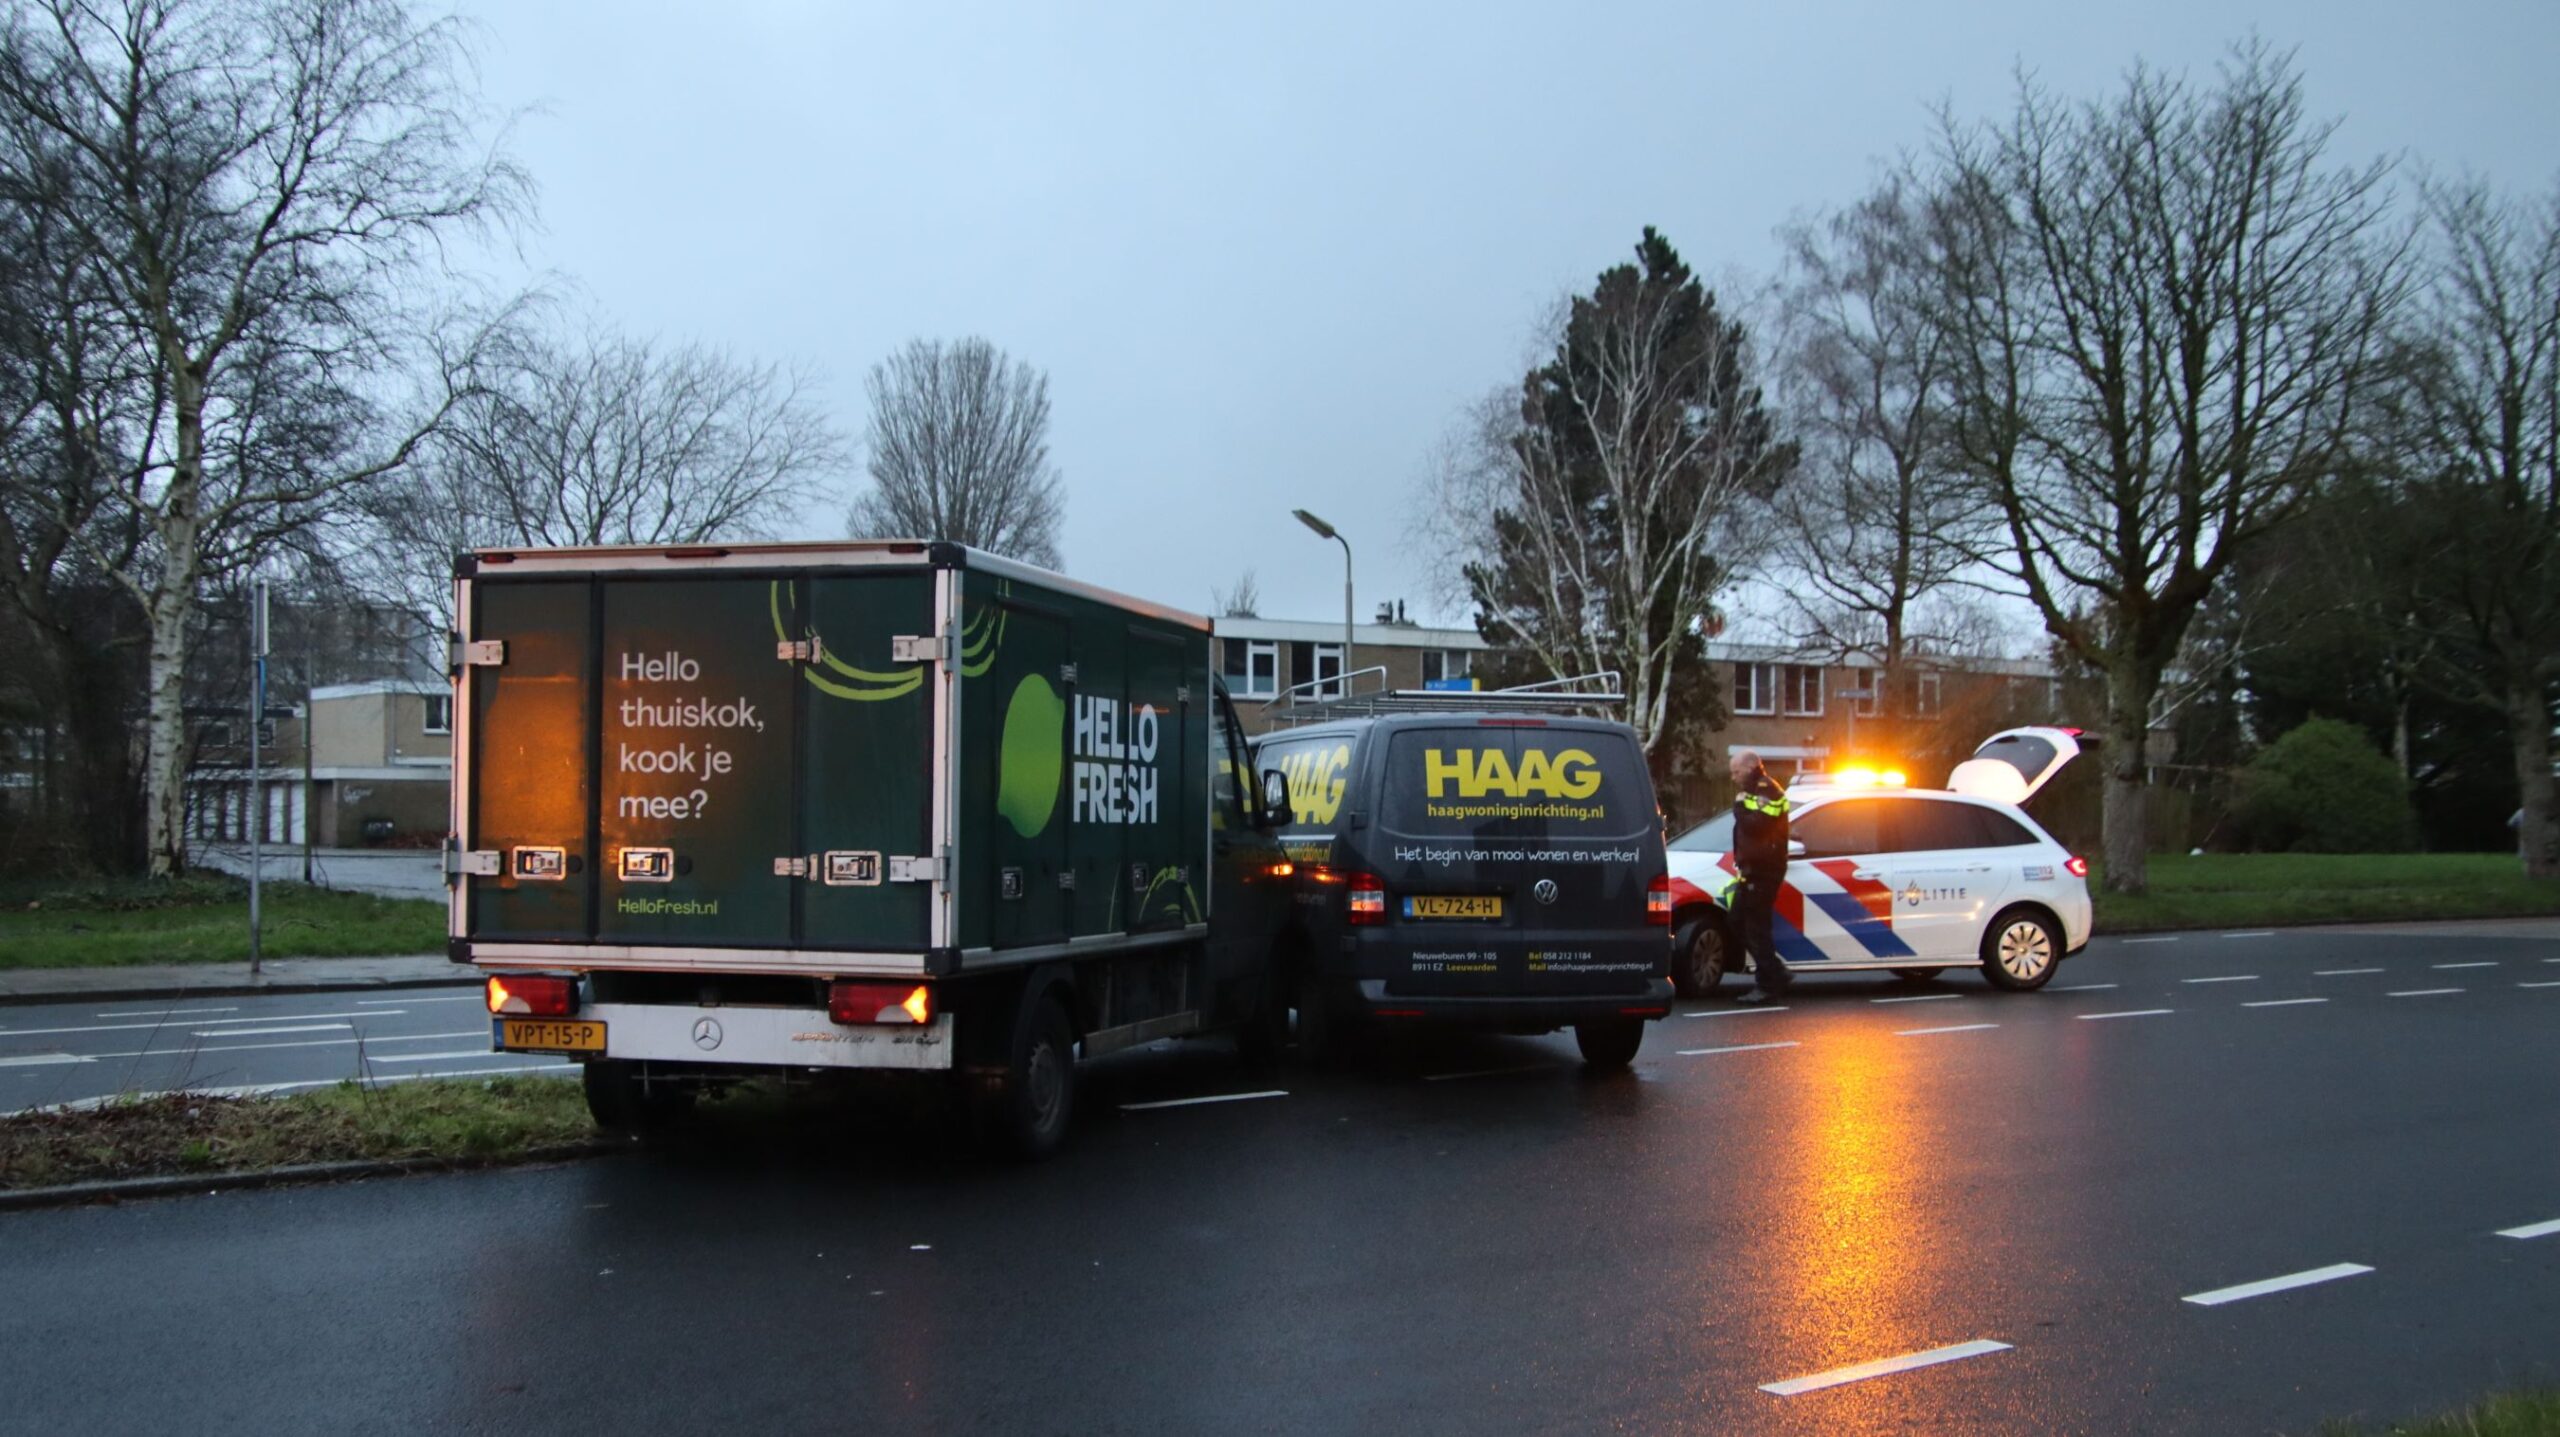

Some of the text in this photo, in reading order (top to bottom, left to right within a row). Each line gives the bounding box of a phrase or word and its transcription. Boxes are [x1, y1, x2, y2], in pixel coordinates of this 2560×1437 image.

[621, 651, 699, 682] Hello
[620, 697, 764, 733] thuiskok,
[1074, 693, 1159, 763] HELLO
[620, 743, 732, 782] kook je
[1425, 748, 1601, 799] HAAG
[619, 789, 708, 819] mee?
[1073, 761, 1158, 825] FRESH
[1427, 803, 1604, 821] haagwoninginrichting.nl
[1394, 846, 1422, 861] Het
[1426, 846, 1461, 867] begin
[1464, 849, 1489, 861] van
[1493, 848, 1525, 861] mooi
[1527, 850, 1570, 861] wonen
[1572, 850, 1588, 861] en
[618, 898, 718, 915] HelloFresh.nl
[1417, 898, 1494, 914] VL-724-H
[1446, 963, 1497, 971] Leeuwarden
[511, 1023, 594, 1047] VPT-15-P
